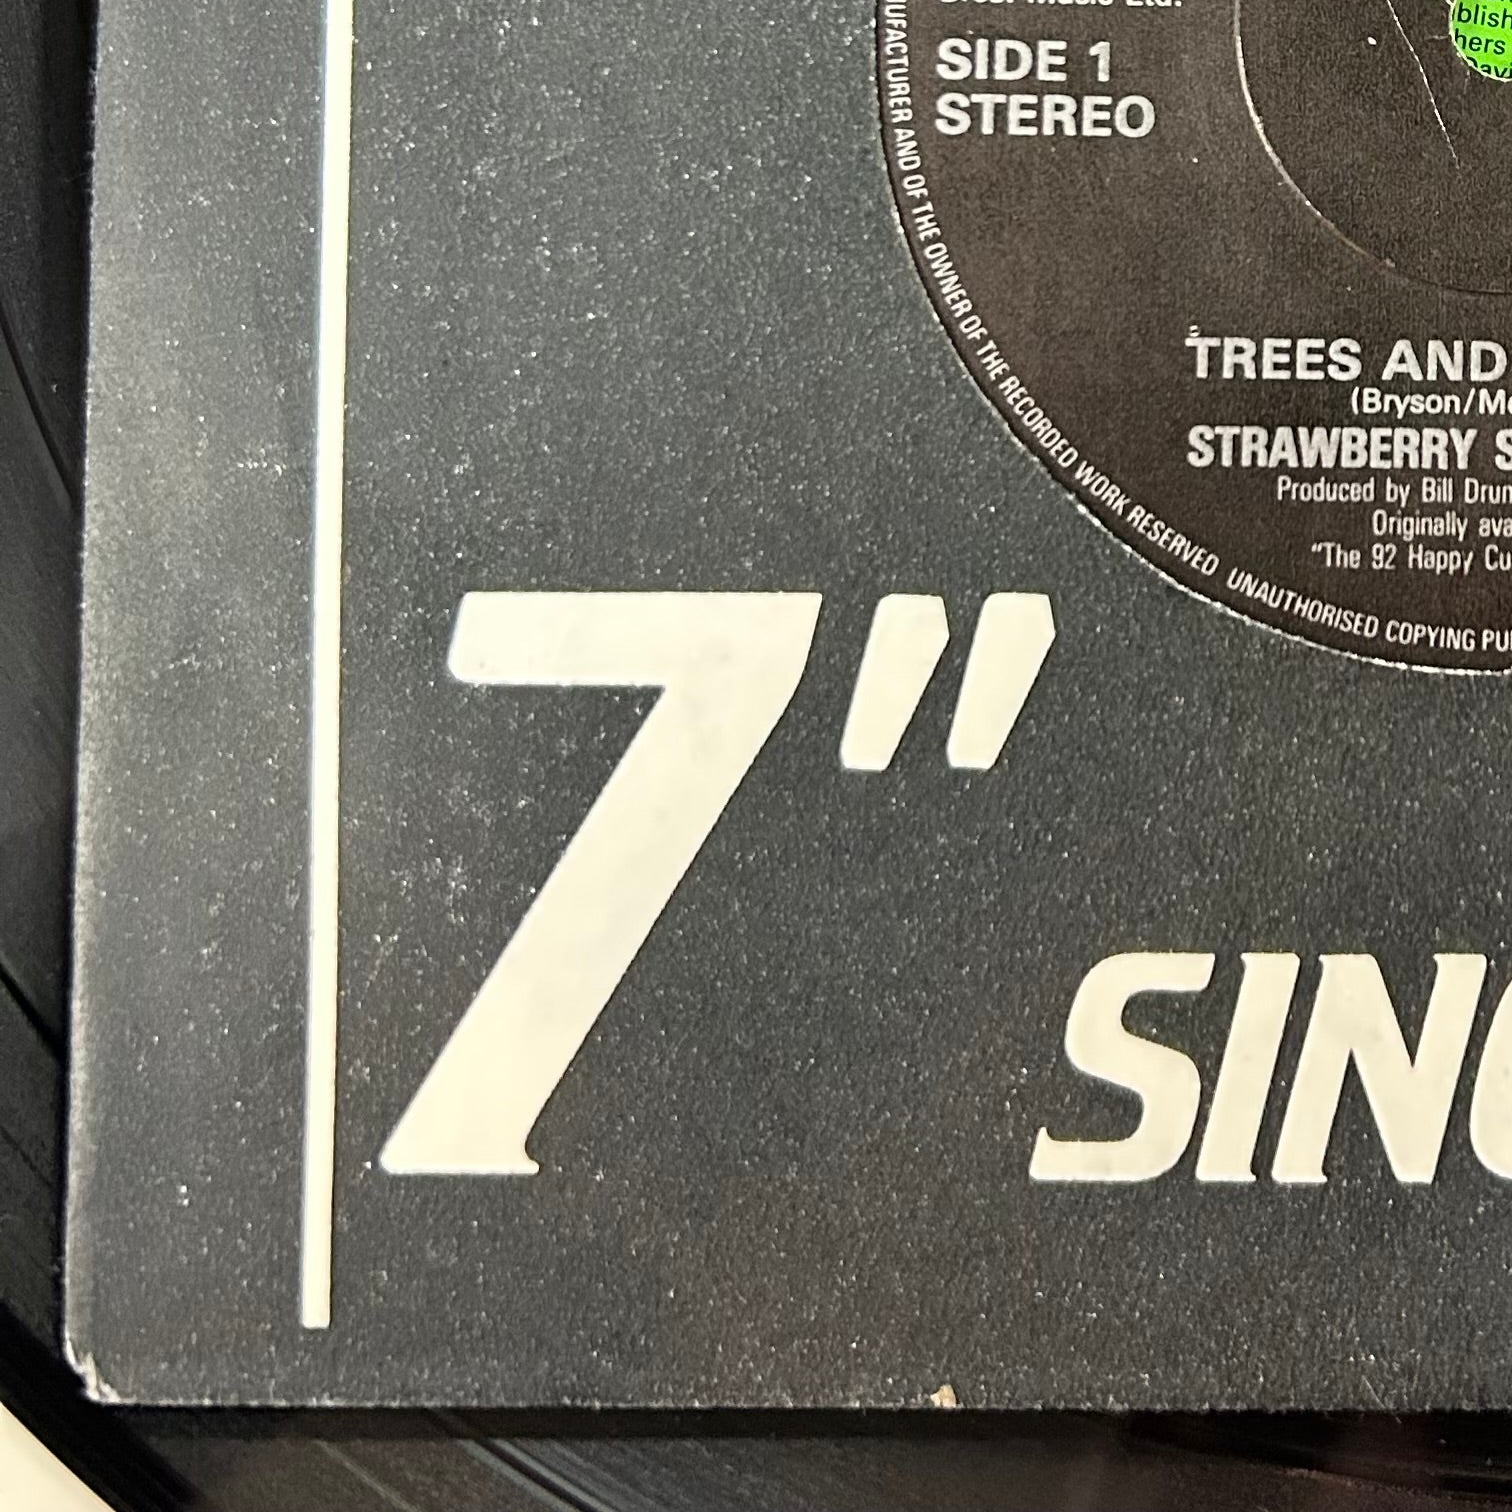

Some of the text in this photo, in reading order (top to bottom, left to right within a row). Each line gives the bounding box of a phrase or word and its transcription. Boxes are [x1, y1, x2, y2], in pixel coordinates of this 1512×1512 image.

[935, 37, 1112, 83] SIDE 1
[935, 92, 1156, 138] STEREO
[894, 126, 922, 172] AND
[902, 173, 929, 199] OF
[911, 200, 942, 241] THE
[923, 241, 973, 319] OWNER
[958, 314, 988, 341] OF
[976, 339, 1010, 382] THE
[1185, 336, 1363, 382] TREES
[1381, 340, 1508, 384] AND
[998, 375, 1079, 469] RECORDED
[1187, 425, 1478, 471] STRAWBERRY
[1073, 460, 1131, 516] WORK
[1277, 475, 1375, 503] Produced
[1385, 476, 1411, 508] by
[1421, 476, 1453, 504] Bill
[1126, 504, 1220, 577] RESERVED
[1372, 509, 1468, 542] Originally
[1371, 543, 1397, 570] 92
[1408, 544, 1474, 576] Happy
[1226, 567, 1380, 638] UNAUTHORISED
[1385, 620, 1476, 652] COPYING
